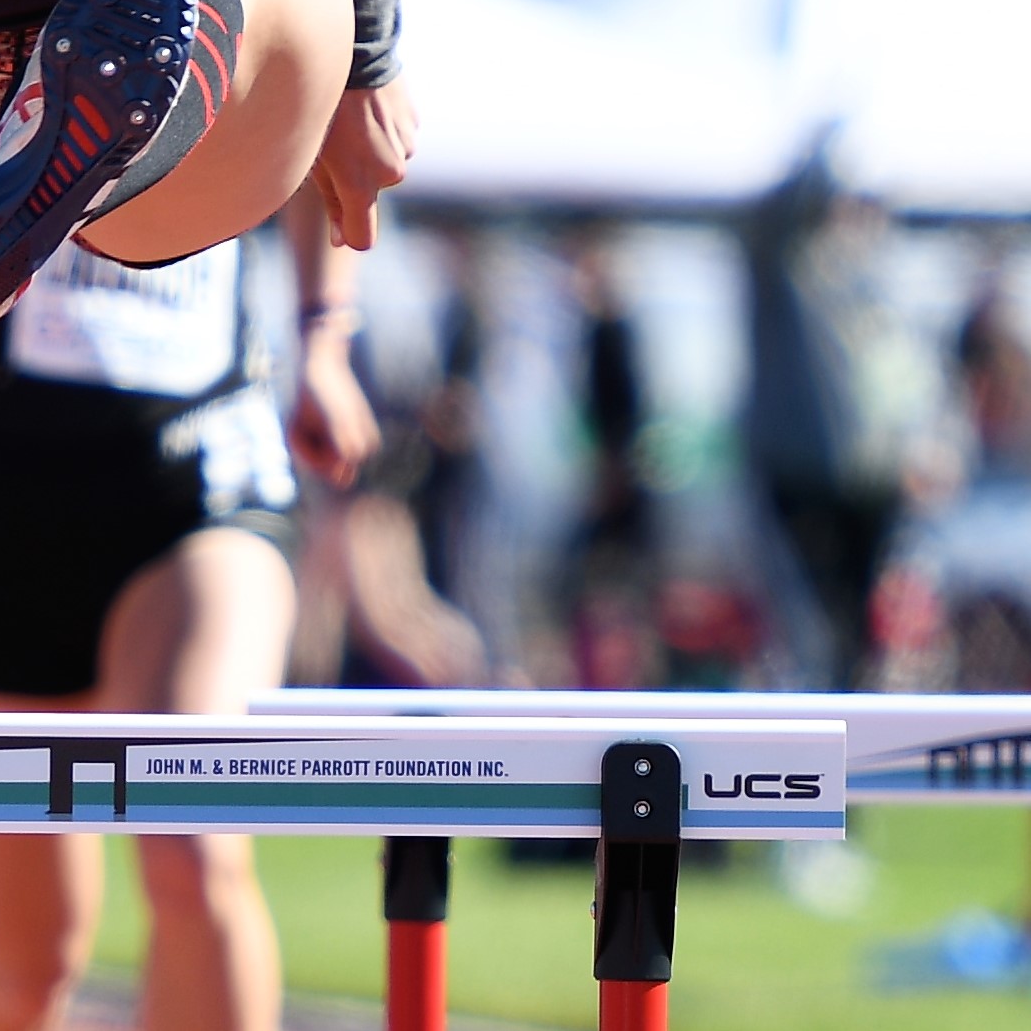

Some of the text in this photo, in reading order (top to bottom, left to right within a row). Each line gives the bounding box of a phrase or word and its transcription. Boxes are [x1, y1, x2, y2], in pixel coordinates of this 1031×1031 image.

[146, 759, 509, 777] JOHN M. & BERNICE PARROTT FOUNDATION INC.
[704, 773, 821, 799] UCS
